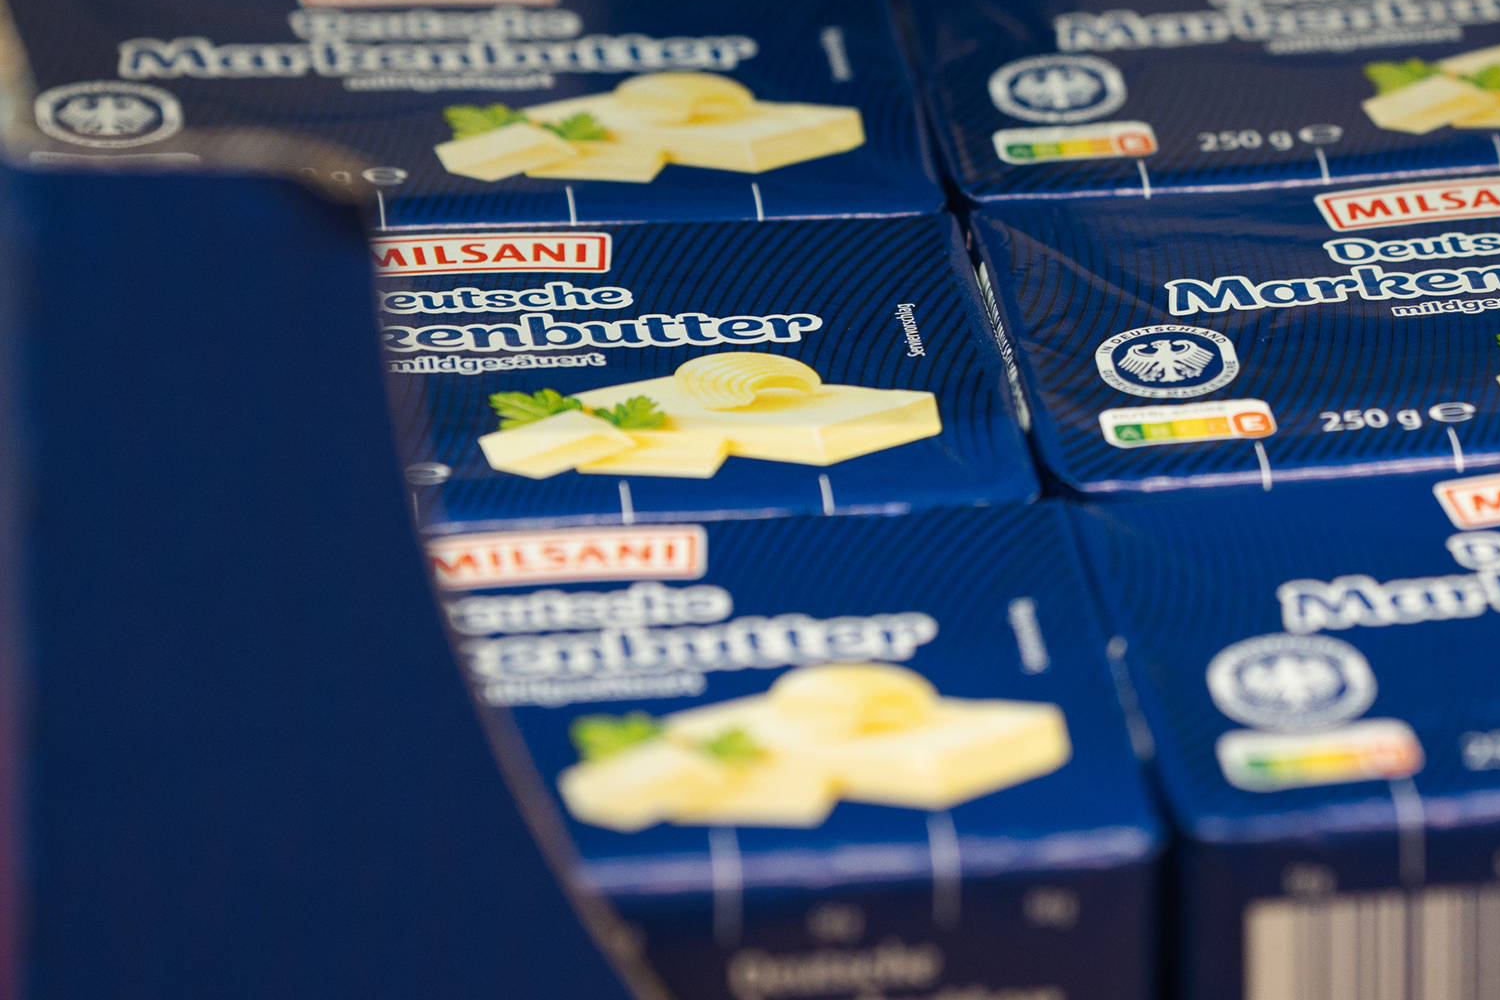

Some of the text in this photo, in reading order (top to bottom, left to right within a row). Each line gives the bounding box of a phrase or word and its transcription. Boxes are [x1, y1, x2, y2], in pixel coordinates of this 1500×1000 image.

[1198, 129, 1294, 152] 250 g
[372, 243, 587, 267] MILSANI
[378, 281, 634, 315] eutsche
[381, 313, 823, 352] enbutter
[1111, 325, 1227, 345] DEUTSCHLAND
[1319, 409, 1388, 432] 250
[1396, 409, 1421, 430] g
